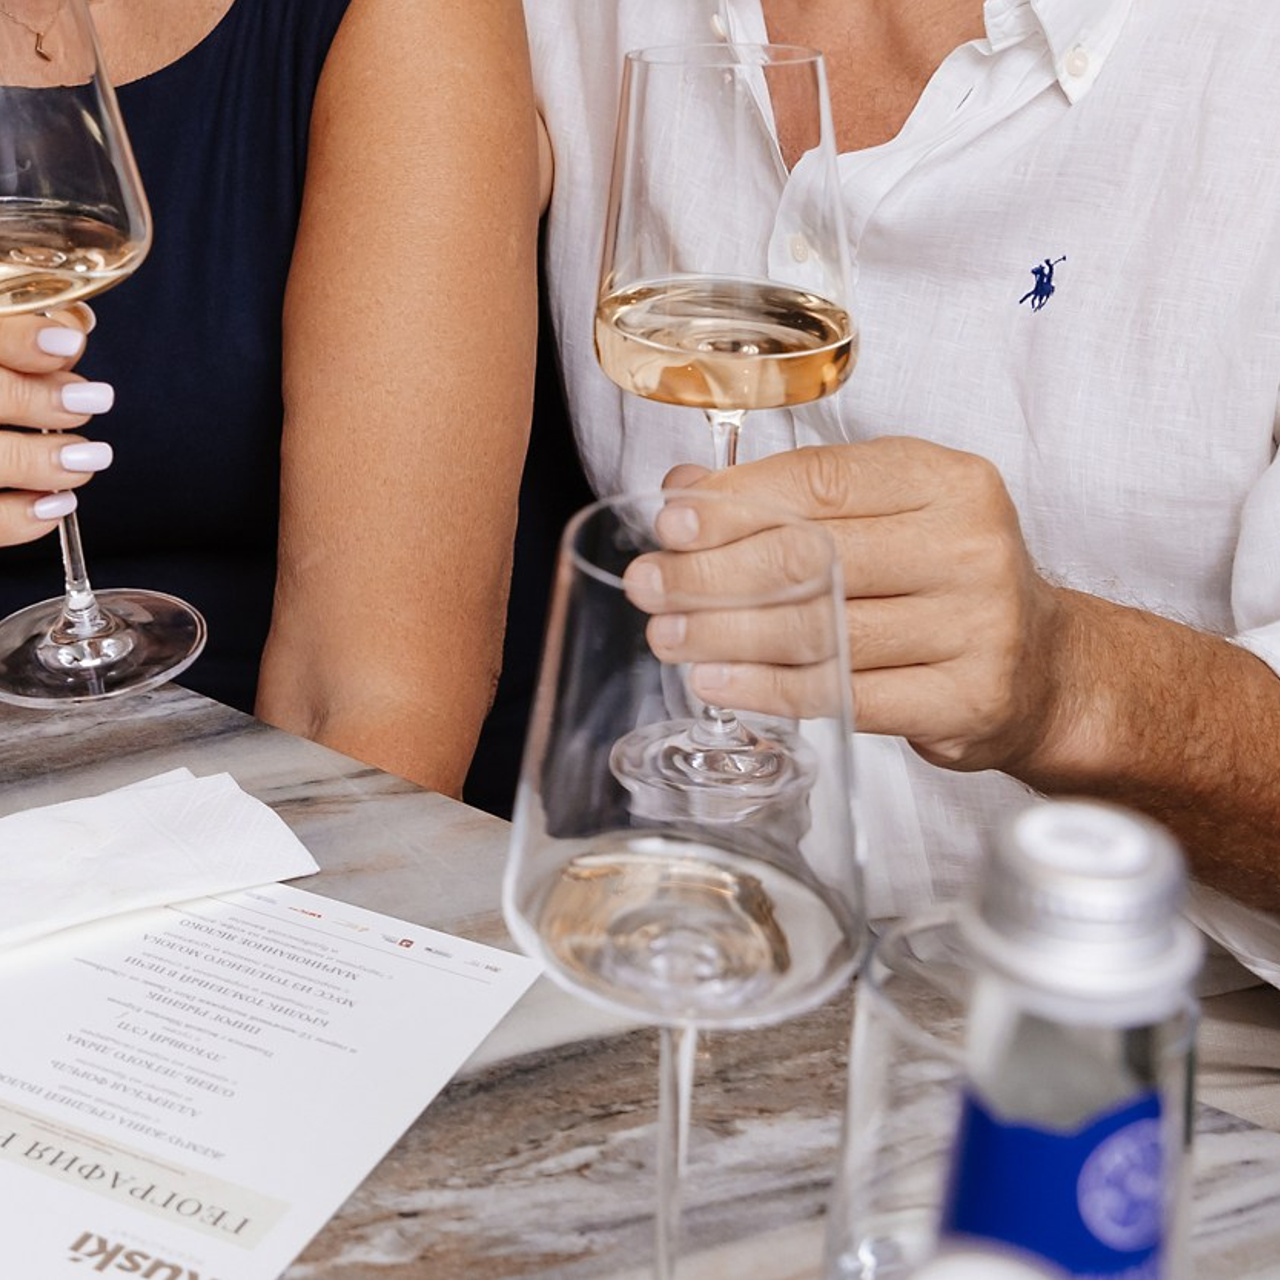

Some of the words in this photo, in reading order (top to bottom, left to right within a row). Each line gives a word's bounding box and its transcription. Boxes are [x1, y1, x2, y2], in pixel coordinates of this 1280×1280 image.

[178, 917, 238, 942] ЯБЛОКО
[139, 931, 204, 958] МОЛОКА
[122, 954, 167, 974] ПЕЧИ
[201, 951, 290, 986] ТОПЛЕНОГО
[239, 936, 360, 981] МАРИНОВАННОЕ
[165, 968, 179, 977] В
[176, 972, 264, 1007] ТОМЛЕНЫЙ
[289, 981, 314, 994] ИЗ
[312, 988, 357, 1008] МУСС
[143, 990, 210, 1017] РЫБНИК
[265, 1001, 330, 1028] КРОЛИК
[115, 1020, 149, 1036] СУП
[211, 1013, 262, 1035] ПИРОГ
[62, 1032, 113, 1055] ДЫМА
[147, 1031, 227, 1065] ЛУКОВЫЙ
[45, 1058, 111, 1086] ФОРЕЛЬ
[110, 1049, 182, 1079] ЛЕГКОГО
[108, 1080, 201, 1118] АДЛЕРСКАЯ
[179, 1073, 237, 1099] ОЛЕНЬ
[40, 1089, 117, 1123] СРЕДНЕЙ
[113, 1115, 226, 1161] ЖЕМЧУЖИНА
[18, 1138, 252, 1237] ГЕОГРАФИЯ
[67, 1230, 221, 1280] uski
